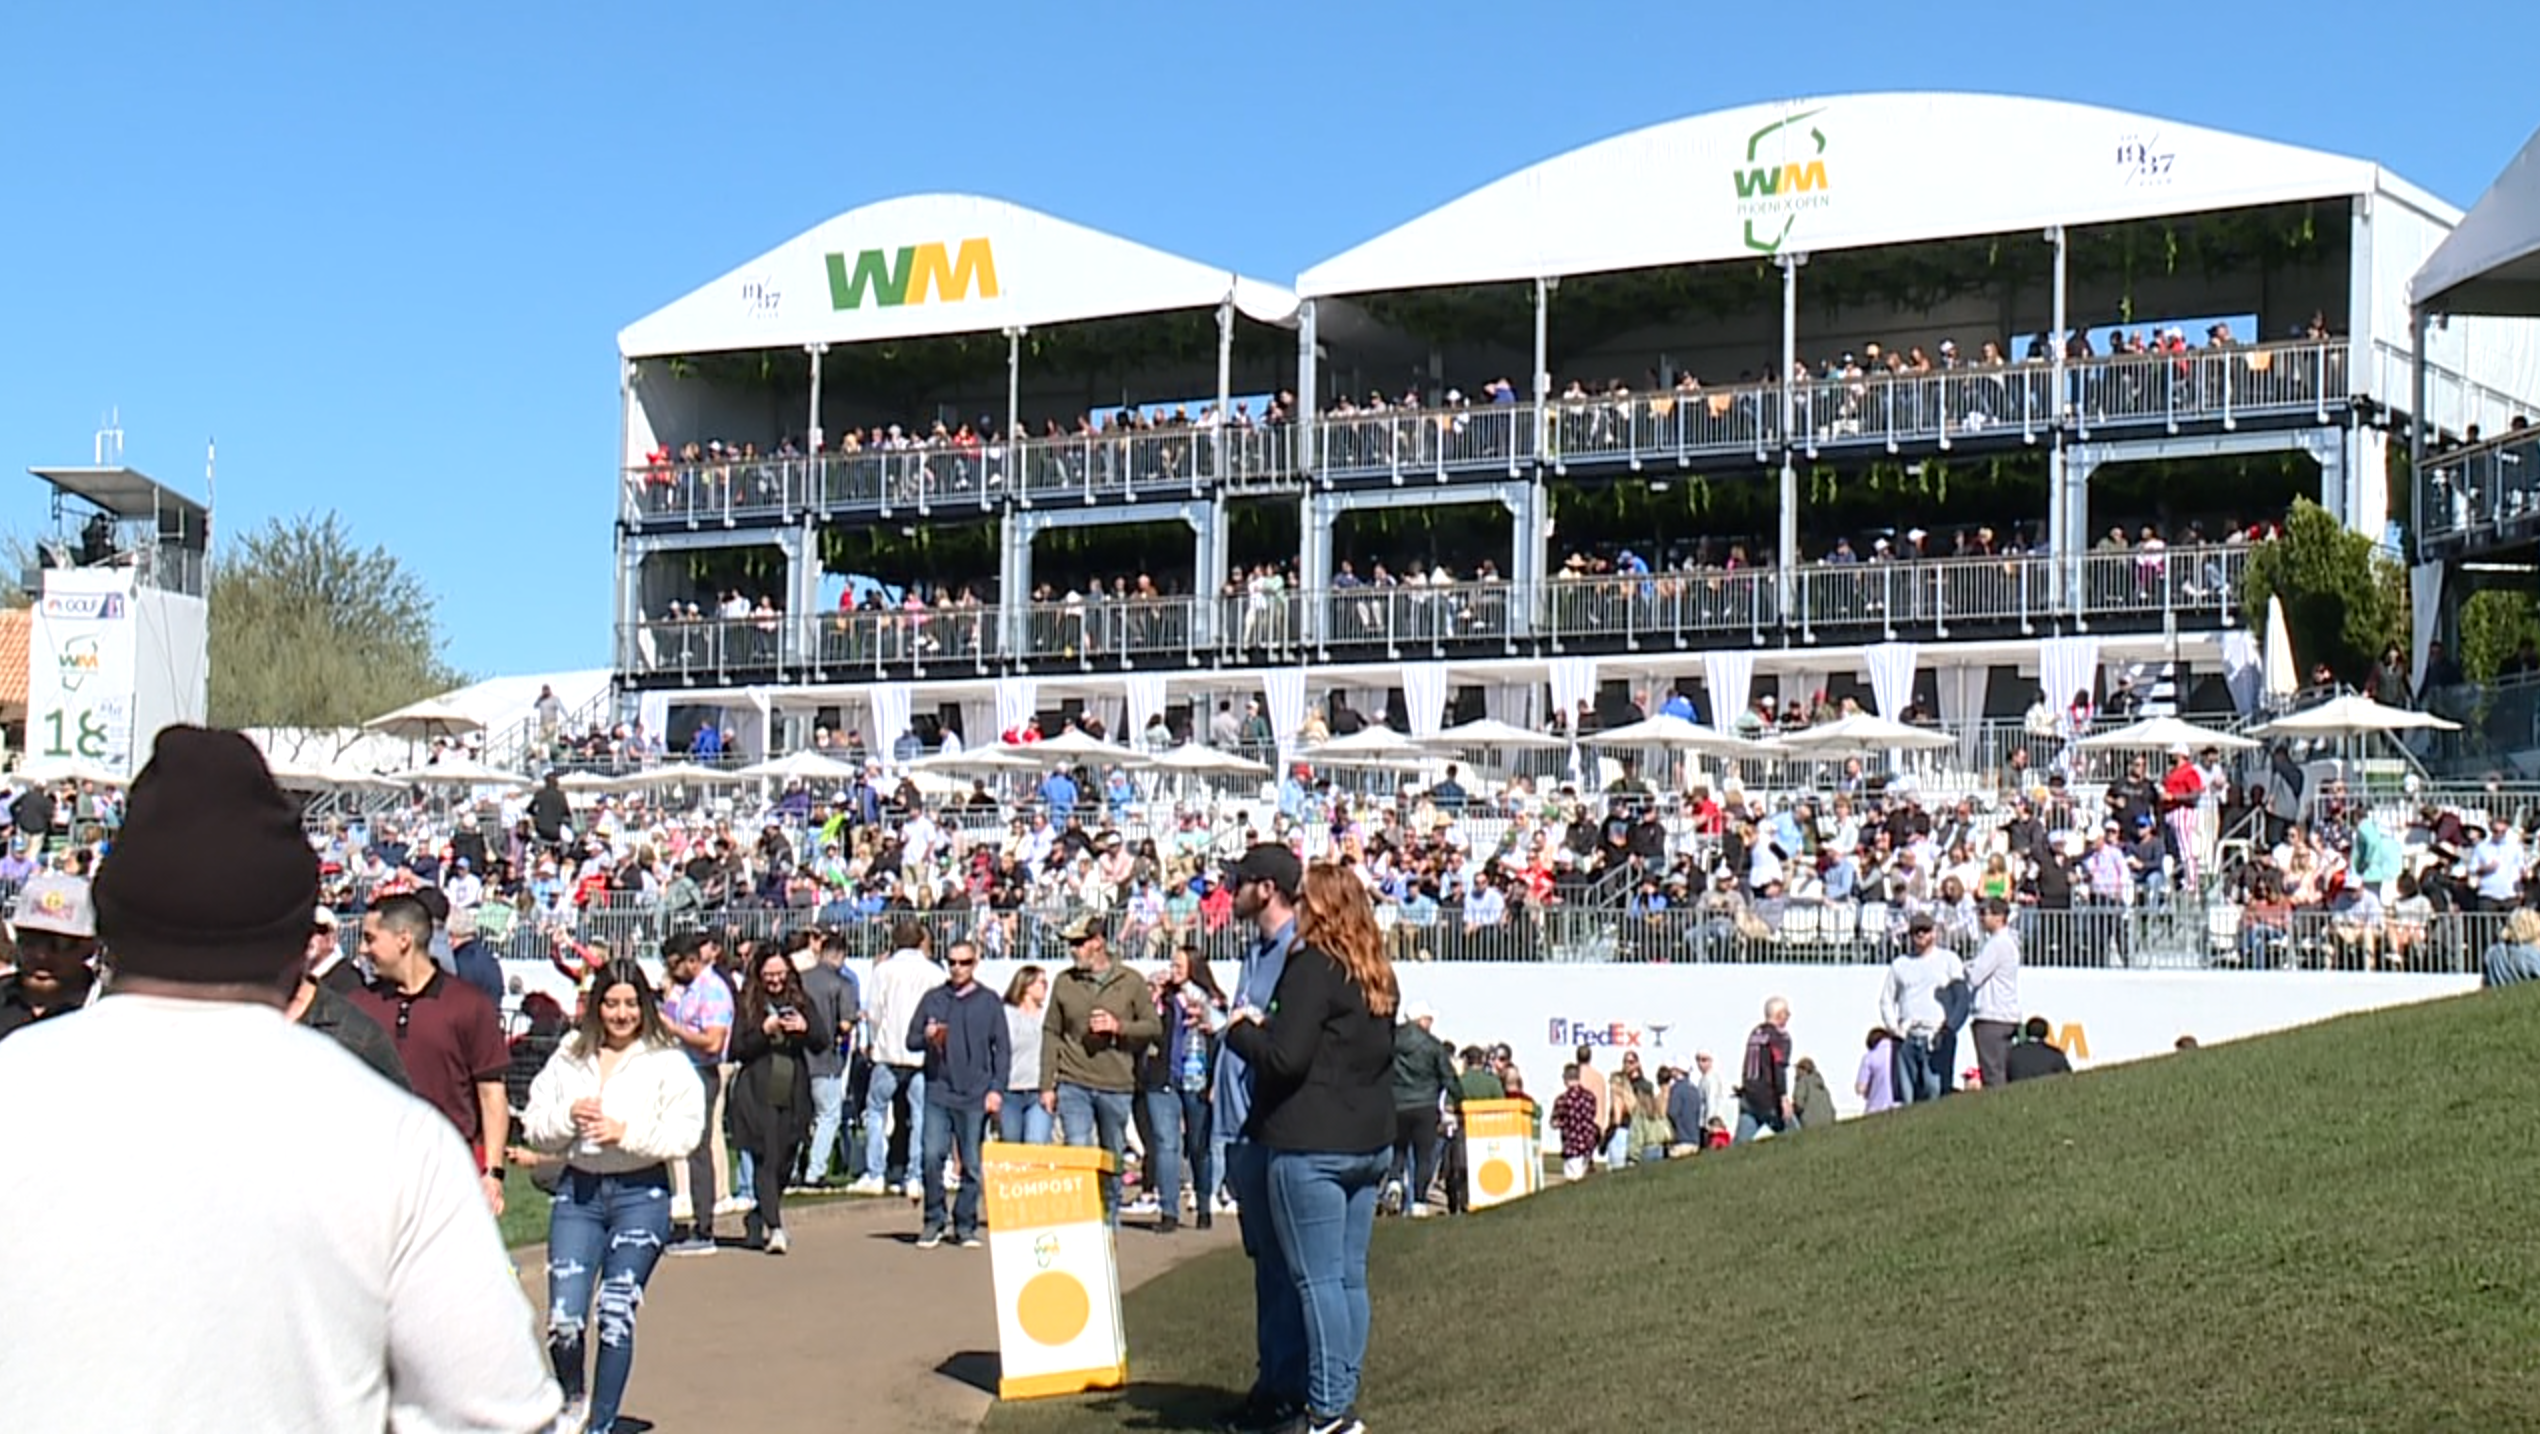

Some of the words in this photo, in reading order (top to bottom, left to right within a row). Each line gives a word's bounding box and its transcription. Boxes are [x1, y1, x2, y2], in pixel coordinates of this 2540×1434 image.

[1733, 160, 1829, 198] WM
[1737, 198, 1792, 216] PHOENIX
[1795, 195, 1829, 211] OPEN
[825, 236, 999, 312] WM
[58, 653, 99, 669] WM
[44, 708, 108, 758] 18
[1572, 1022, 1641, 1048] FedEx
[998, 1176, 1083, 1201] COMPOST
